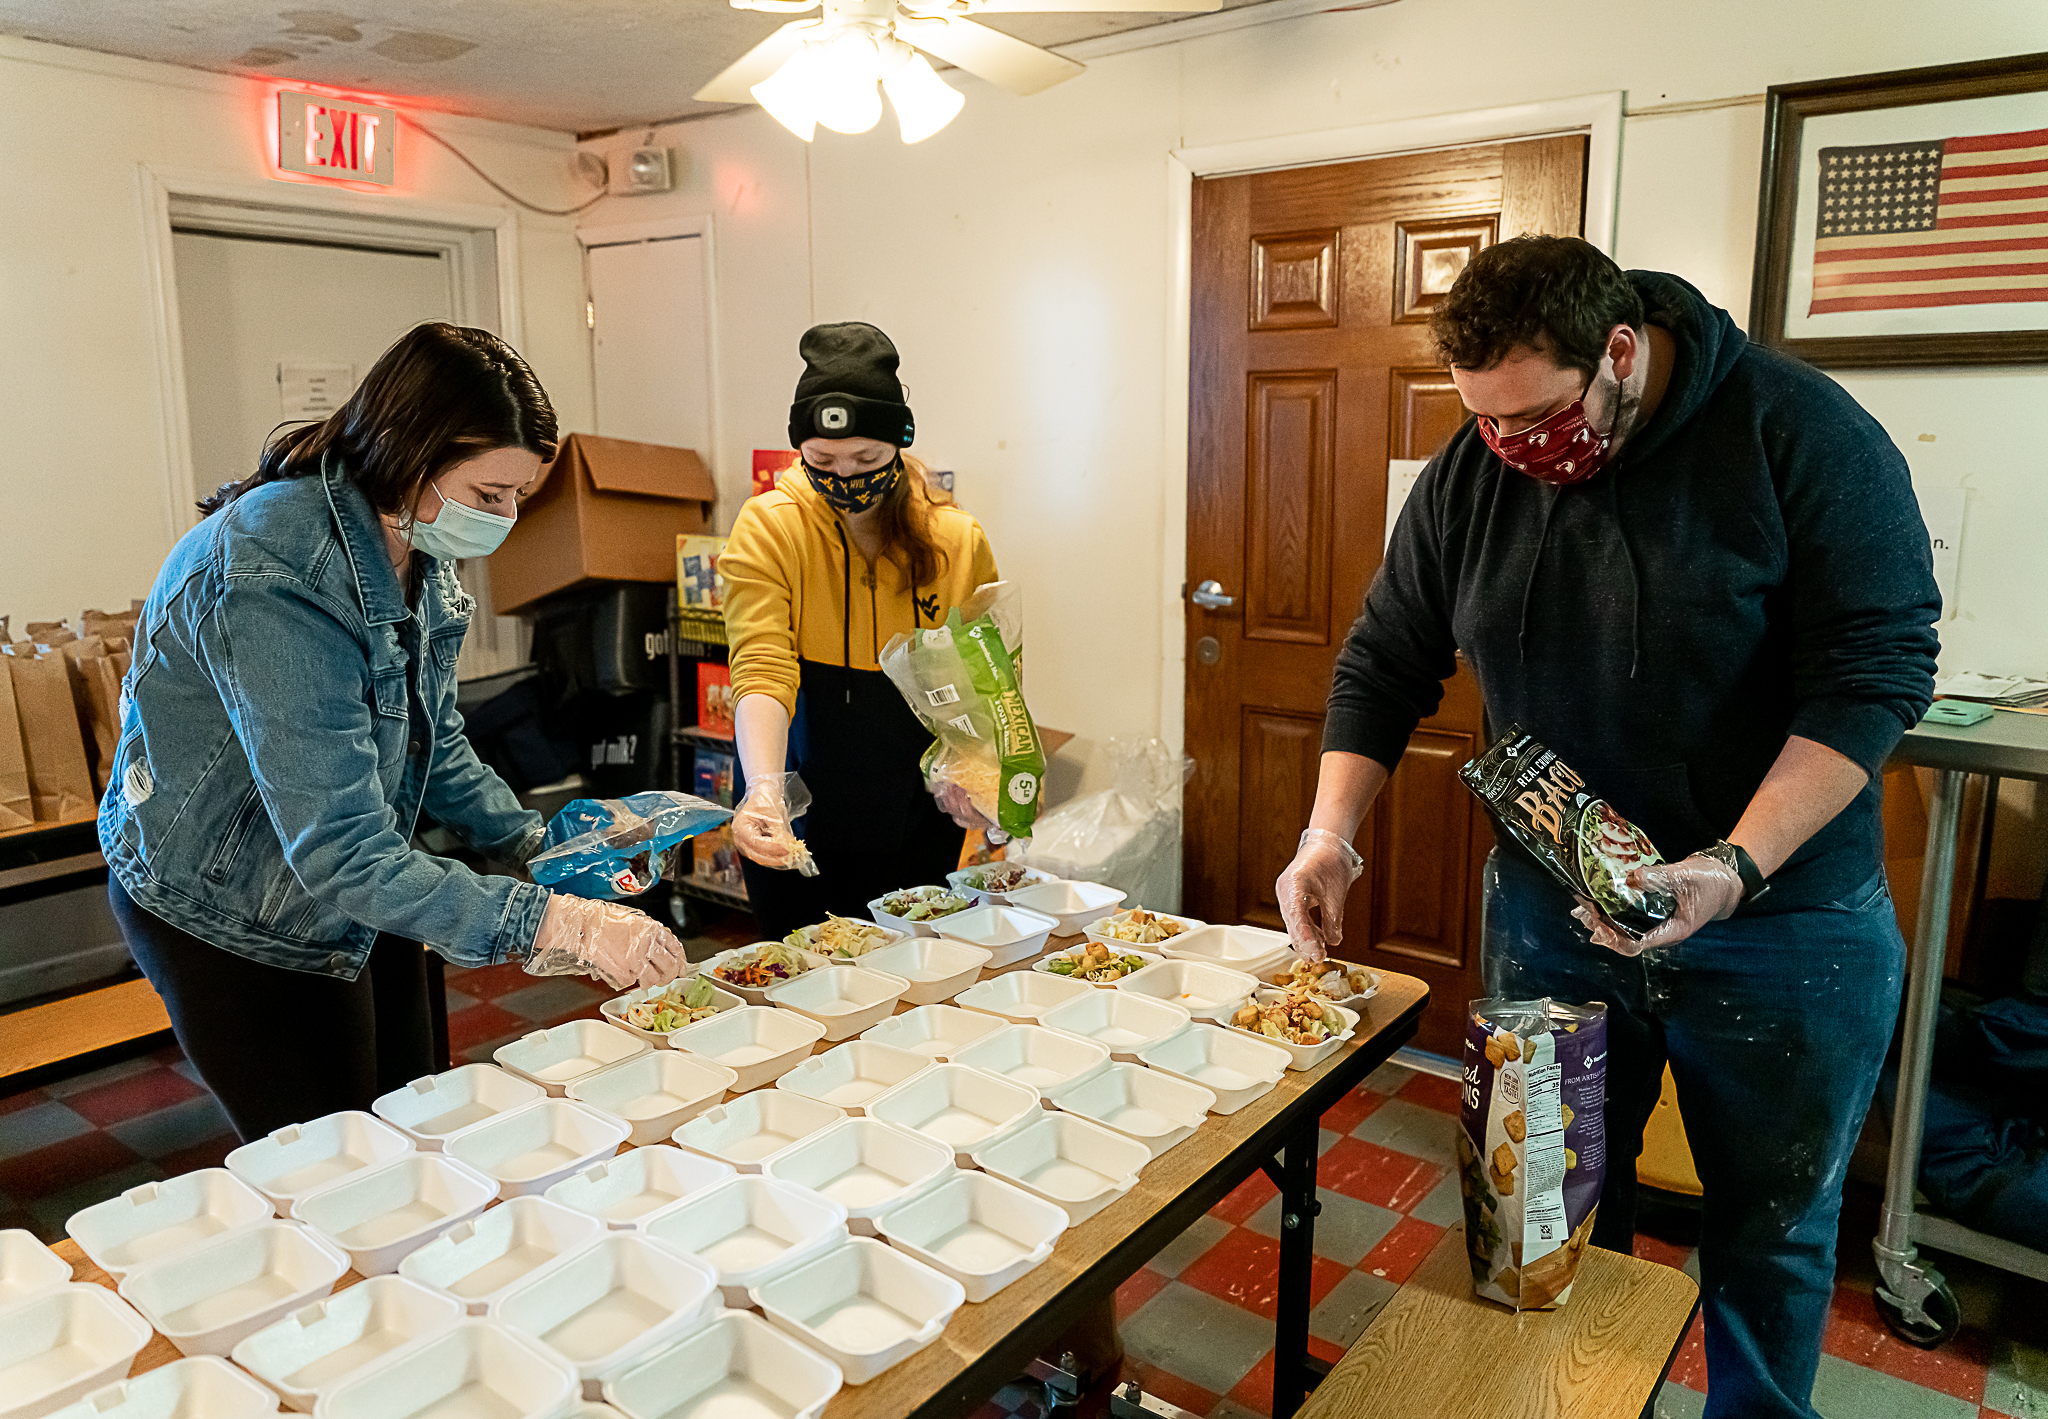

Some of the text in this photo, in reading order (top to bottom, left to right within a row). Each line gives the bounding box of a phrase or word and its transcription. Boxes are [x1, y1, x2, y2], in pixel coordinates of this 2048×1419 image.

[305, 103, 381, 174] EXIT
[1002, 692, 1034, 754] MEXICAN
[606, 734, 638, 765] milk?
[1019, 780, 1033, 798] 5 LB
[1516, 766, 1540, 788] REAL
[1514, 758, 1586, 845] BACO
[1546, 1064, 1561, 1072] Facts
[1564, 1075, 1581, 1086] FROM
